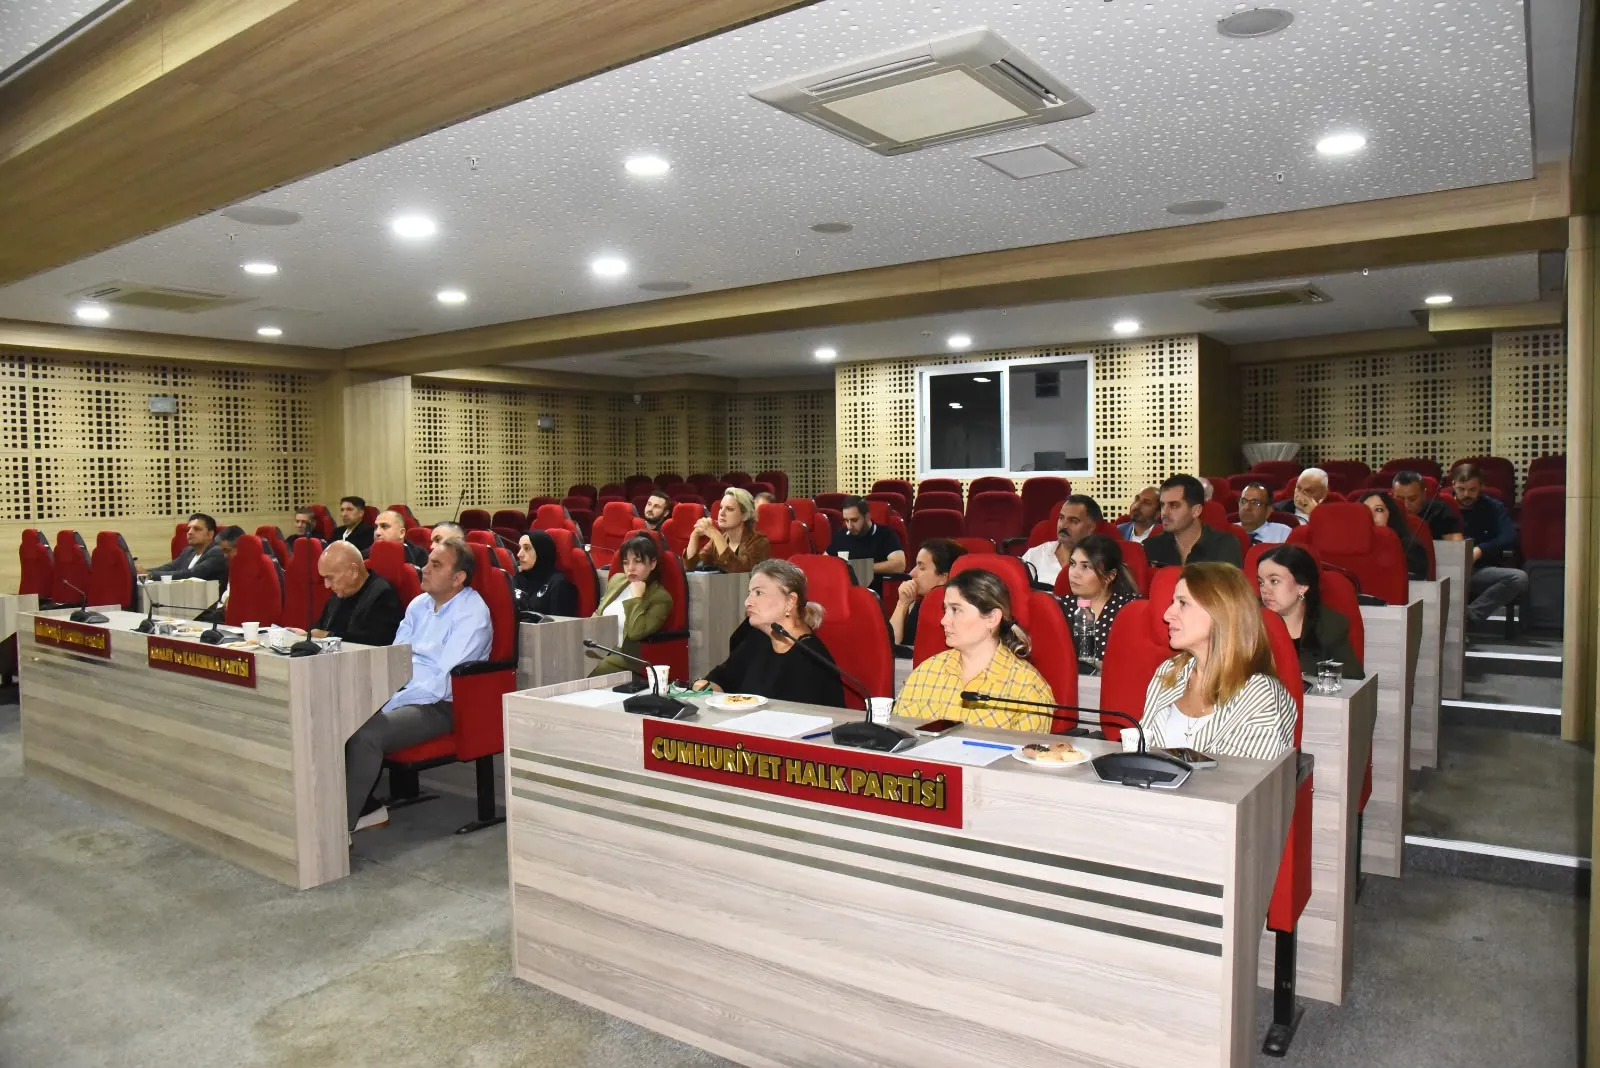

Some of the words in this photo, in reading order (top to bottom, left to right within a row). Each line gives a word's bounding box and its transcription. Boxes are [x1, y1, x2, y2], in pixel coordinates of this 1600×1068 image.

[651, 736, 782, 780] CUMHURİYET
[785, 757, 849, 792] HALK
[850, 769, 947, 809] PARTİSİ
